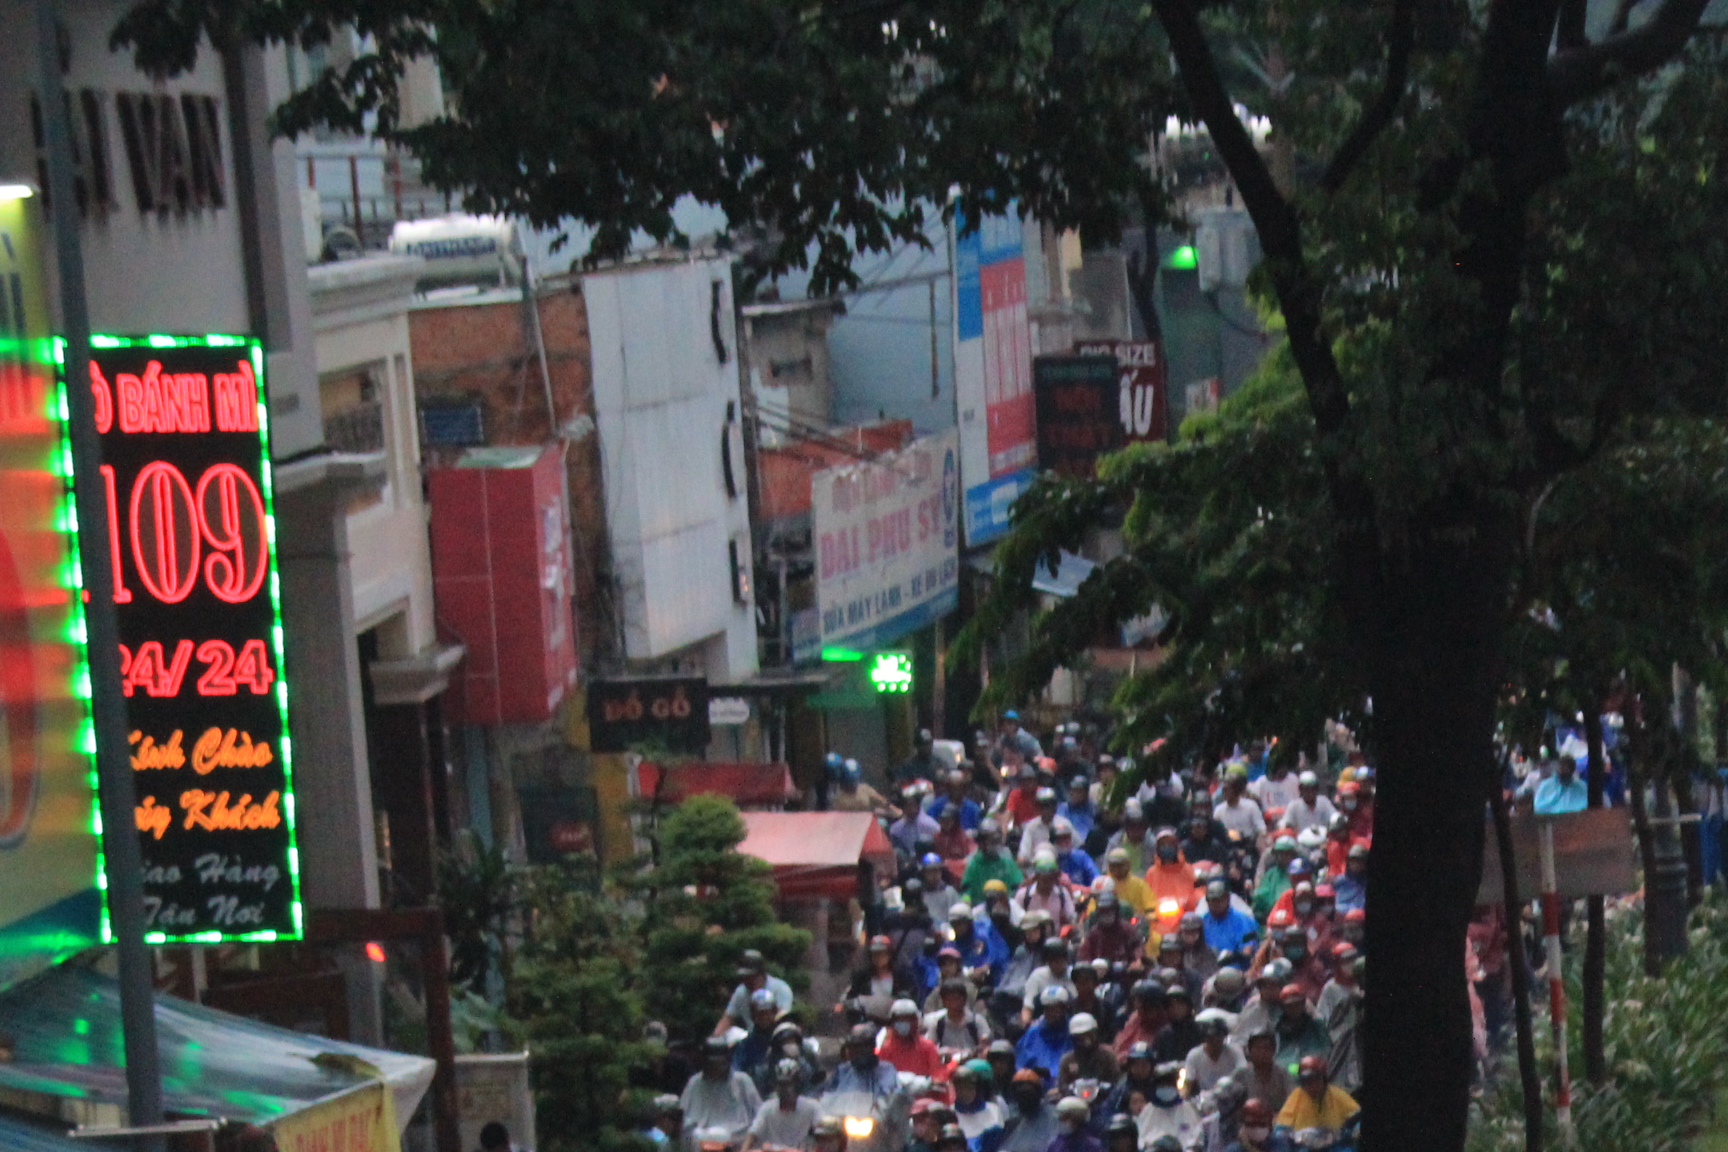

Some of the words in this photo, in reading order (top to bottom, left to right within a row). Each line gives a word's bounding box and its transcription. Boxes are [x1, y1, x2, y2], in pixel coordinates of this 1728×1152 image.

[1115, 343, 1155, 367] SIZE
[89, 359, 113, 434] Ò
[116, 359, 211, 433] BÁNH
[213, 359, 259, 432] MÌ
[100, 460, 269, 604] 109
[192, 726, 273, 775] Chào
[180, 789, 281, 832] Khách
[143, 859, 181, 884] iao
